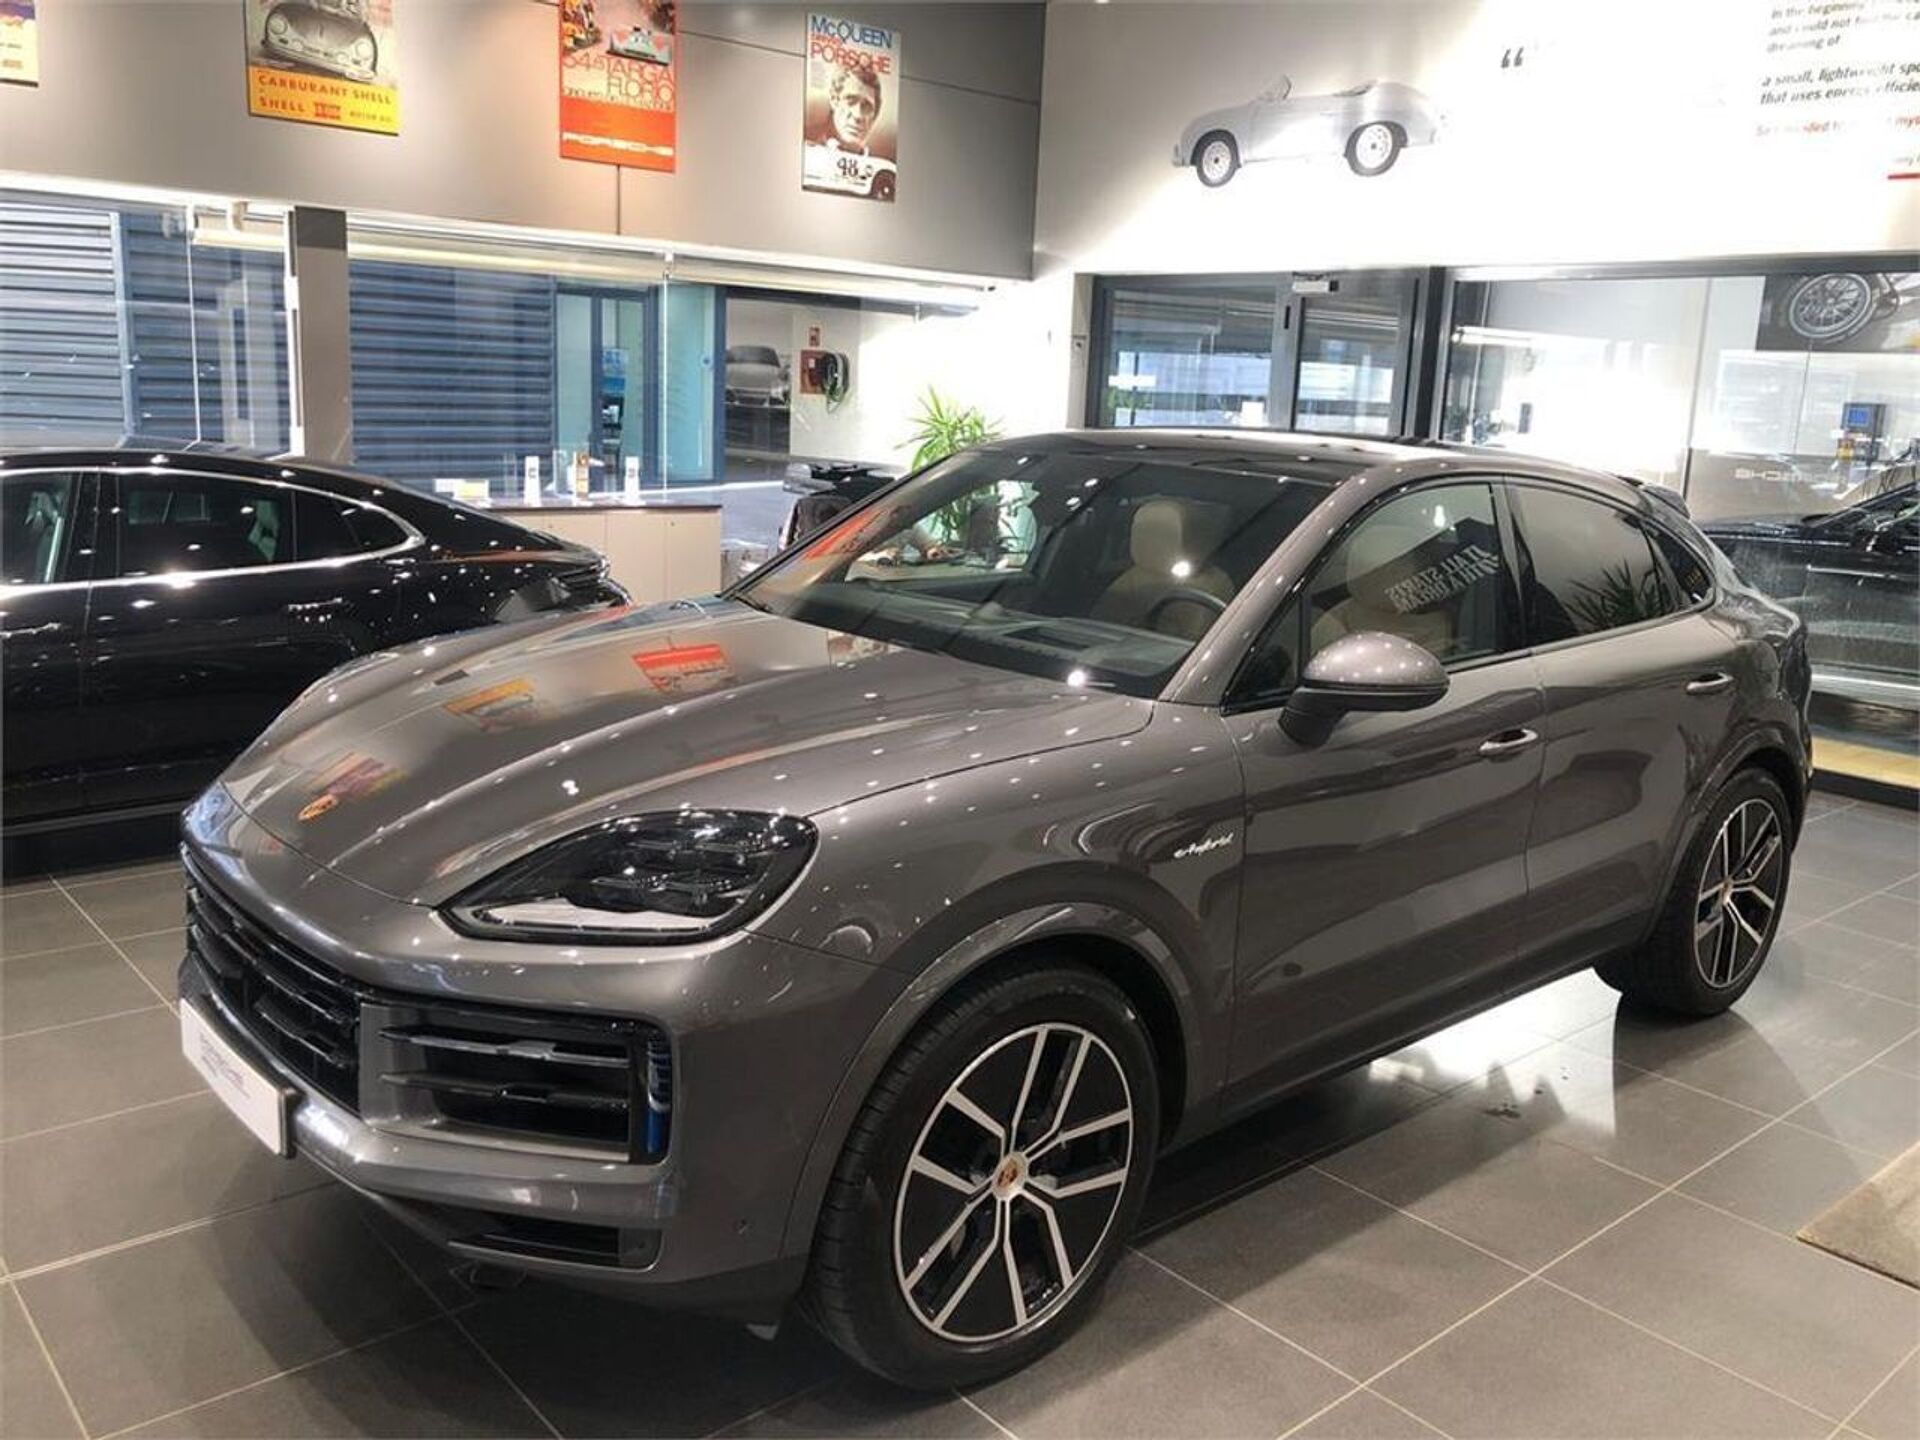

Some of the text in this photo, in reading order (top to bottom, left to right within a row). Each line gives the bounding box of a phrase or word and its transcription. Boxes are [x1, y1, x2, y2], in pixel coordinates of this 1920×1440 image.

[811, 41, 891, 75] PORSCHE
[259, 74, 392, 105] CARBURANT SHELL
[260, 96, 305, 113] SHELL
